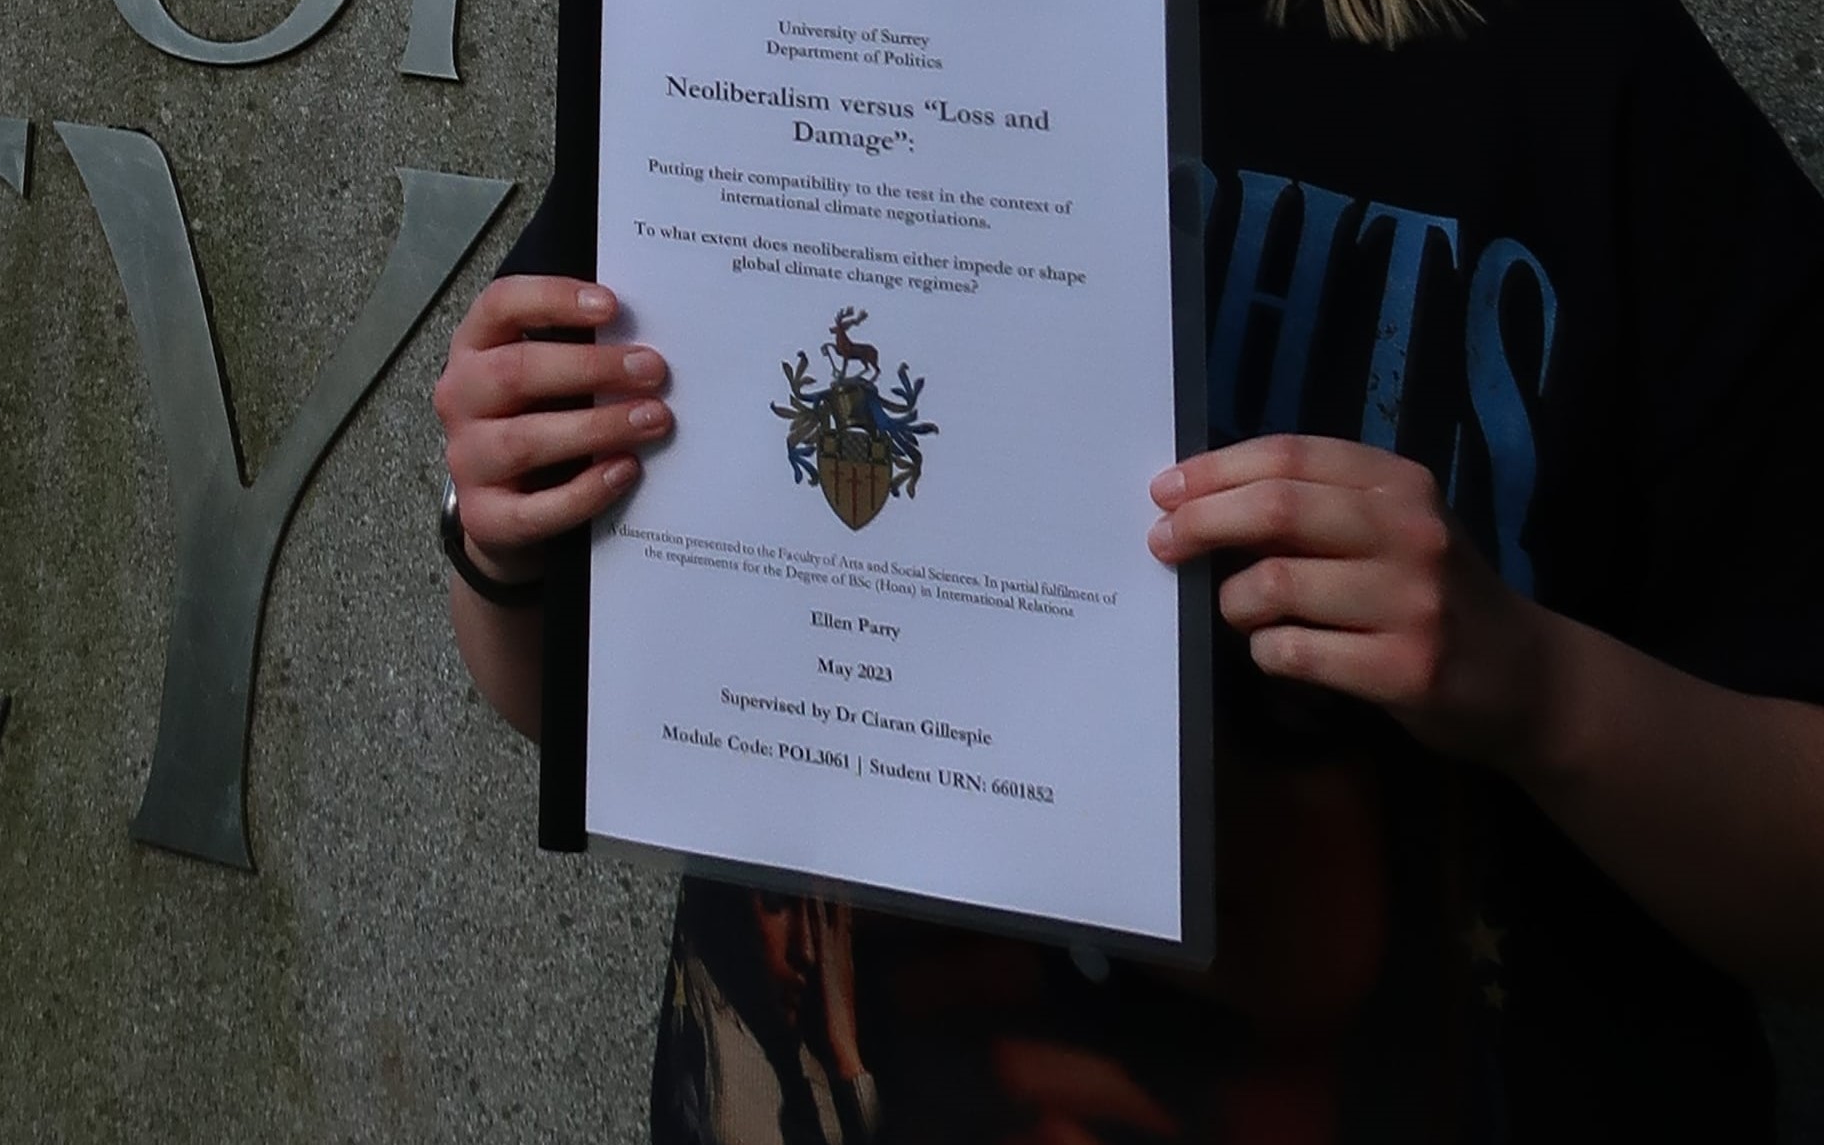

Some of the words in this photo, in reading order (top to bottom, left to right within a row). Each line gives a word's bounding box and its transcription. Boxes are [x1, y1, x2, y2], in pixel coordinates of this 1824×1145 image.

[766, 39, 859, 62] Department
[863, 50, 881, 64] of
[884, 50, 943, 70] Politics
[778, 20, 856, 44] University
[862, 27, 878, 42] of
[881, 28, 930, 51] Surrey
[665, 74, 830, 111] Neoliberalism
[839, 97, 914, 119] versus
[924, 100, 995, 126] “Loss
[1004, 109, 1051, 132] and
[792, 120, 915, 156] Damage”:
[648, 157, 704, 182] Putting
[708, 165, 744, 183] their
[748, 171, 851, 197] compatibility
[855, 183, 871, 196] to
[876, 182, 901, 199] the
[906, 188, 934, 202] test
[939, 187, 955, 204] in
[959, 191, 985, 206] the
[989, 196, 1050, 214] context
[1054, 200, 1073, 215] of
[720, 187, 820, 212] international
[825, 198, 882, 218] climate
[886, 207, 992, 230] negotiations.
[634, 219, 656, 237] To
[660, 225, 696, 243] what
[701, 233, 748, 248] extent
[753, 235, 788, 252] does
[792, 242, 898, 264] neoliberalism
[903, 251, 949, 270] either
[953, 255, 1013, 277] impede
[1017, 267, 1035, 279] or
[1039, 265, 1087, 287] shape
[732, 256, 780, 274] global
[785, 261, 843, 282] climate
[847, 268, 903, 290] change
[908, 275, 979, 295] regimes?
[1201, 159, 1558, 601] HTS
[619, 524, 684, 545] dissertation
[685, 535, 742, 554] presented
[743, 543, 755, 556] to
[757, 545, 776, 559] the
[778, 547, 821, 569] Faculty
[823, 553, 837, 565] of
[840, 556, 864, 570] Arts
[867, 561, 889, 574] and
[891, 563, 927, 579] Social
[984, 574, 998, 589] In
[1001, 579, 1039, 595] partial
[1041, 582, 1100, 603] fulfilment
[1103, 591, 1119, 606] of
[644, 546, 663, 561] the
[666, 552, 739, 571] requirements
[743, 560, 760, 575] for
[763, 563, 782, 578] the
[786, 565, 828, 586] Degree
[831, 573, 846, 586] of
[849, 574, 871, 590] BSc
[875, 579, 917, 599] (Hons)
[920, 585, 932, 598] in
[936, 587, 1015, 610] International
[1018, 597, 1076, 618] Relations
[810, 610, 853, 631] Ellen
[857, 617, 901, 642] Parry
[817, 656, 853, 681] May
[857, 663, 894, 683] 2023
[720, 687, 806, 716] Supervised
[812, 702, 831, 724] by
[836, 705, 856, 724] Dr
[861, 709, 916, 735] Ciaran
[920, 719, 994, 748] Gillespie
[661, 724, 722, 749] Module
[727, 734, 773, 757] Code:
[778, 742, 850, 770] POL3061
[869, 758, 931, 784] Student
[938, 768, 987, 794] URN:
[991, 777, 1056, 804] 6601852
